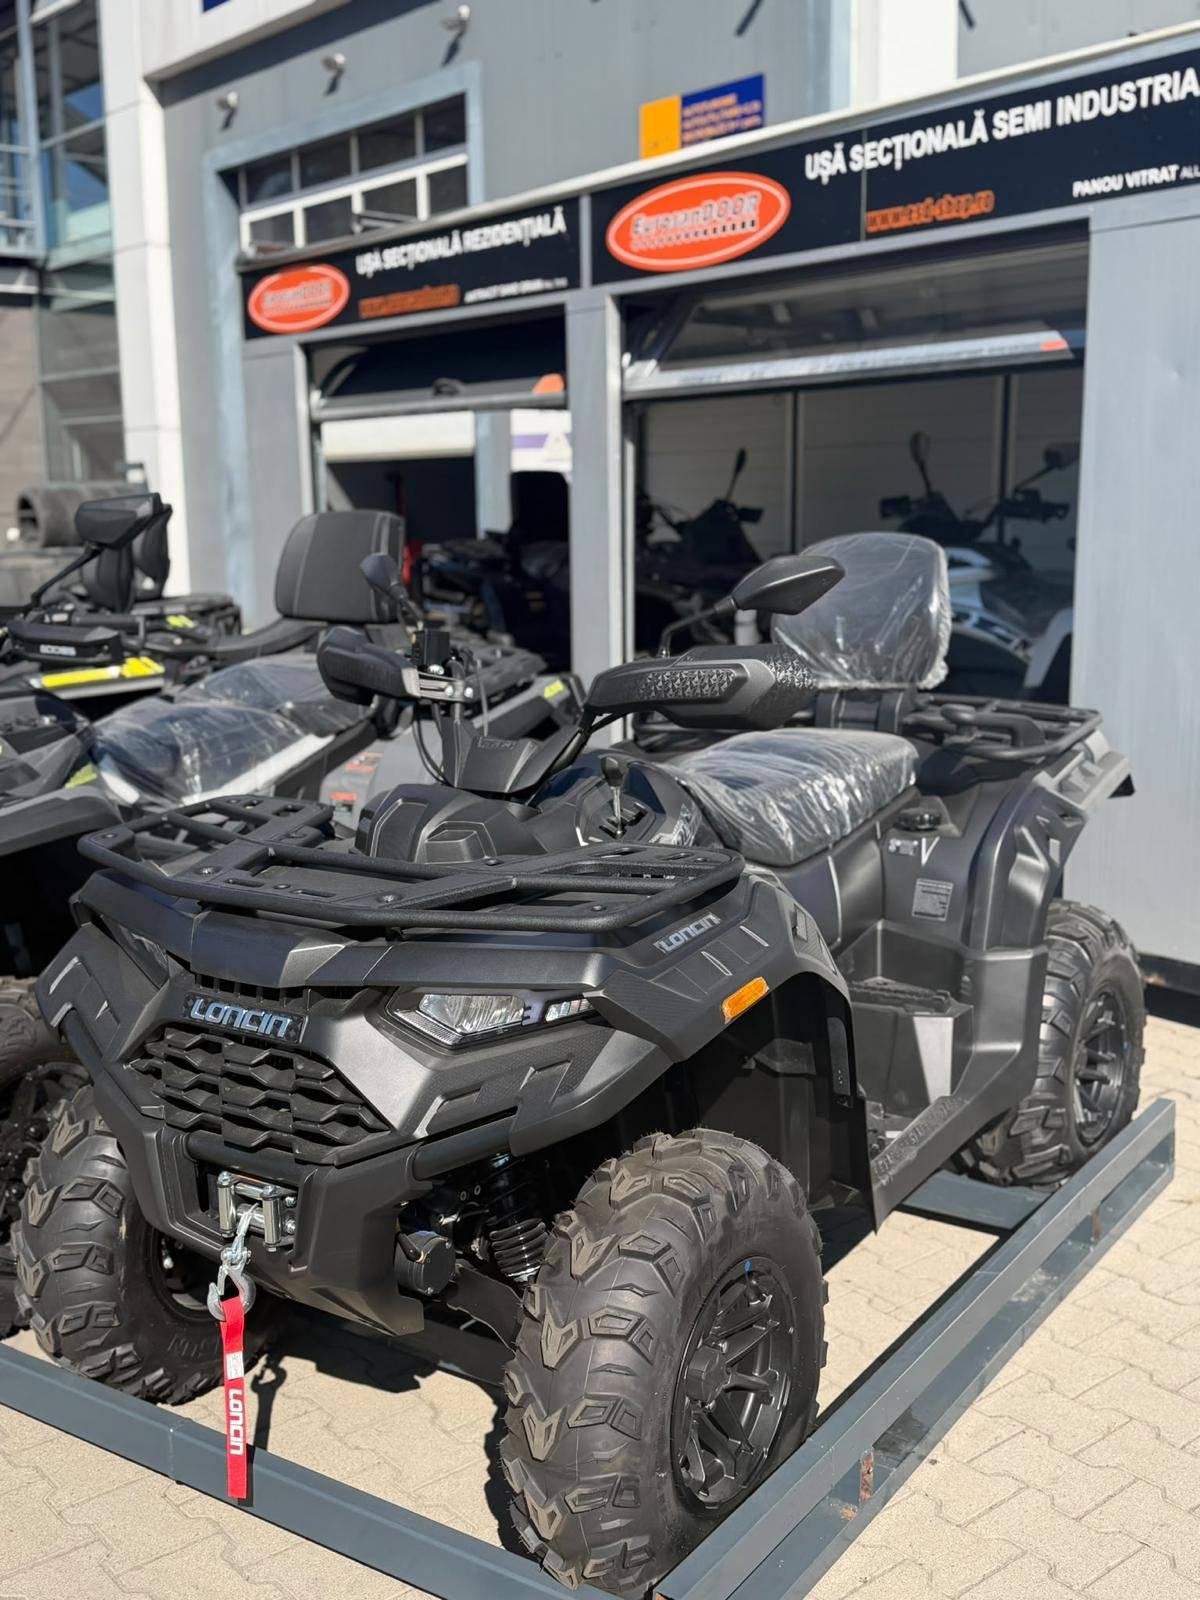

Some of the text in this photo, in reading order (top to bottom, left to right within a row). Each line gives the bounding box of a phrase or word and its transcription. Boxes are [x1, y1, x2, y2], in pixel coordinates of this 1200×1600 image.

[992, 100, 1051, 140] SEMI
[1056, 67, 1200, 126] INDUSTRIA
[1072, 174, 1123, 197] PANOU
[1125, 164, 1180, 188] VITRAT
[228, 1388, 244, 1456] LONCIN
